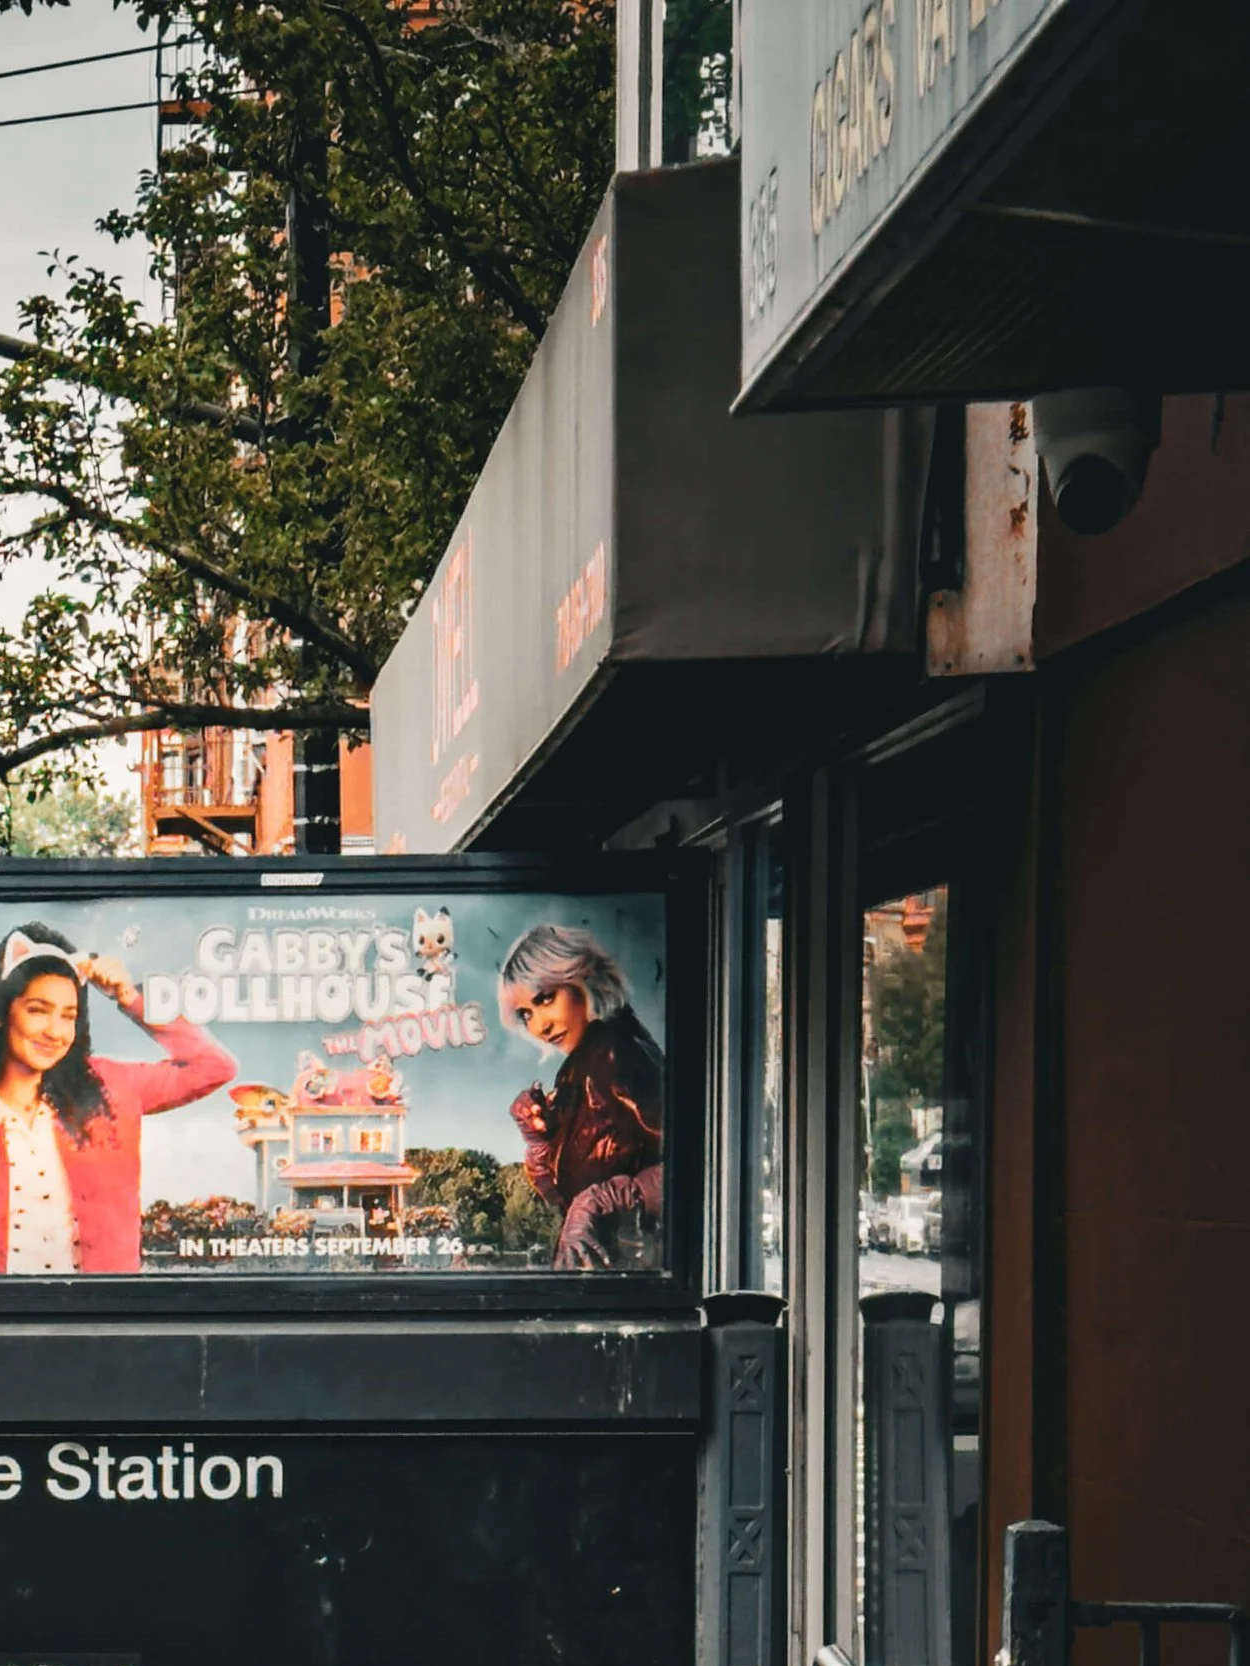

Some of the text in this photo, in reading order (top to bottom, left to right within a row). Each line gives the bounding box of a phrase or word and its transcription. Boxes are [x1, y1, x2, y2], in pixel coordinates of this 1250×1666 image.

[810, 0, 895, 238] CIGARS
[198, 927, 411, 974] GABBY'S
[144, 972, 456, 1025] DOLLHOUSE
[321, 1002, 488, 1063] THE MOVIE
[179, 1236, 464, 1257] IN THEATERS SEPTEMBER 26
[46, 1442, 285, 1500] Station
